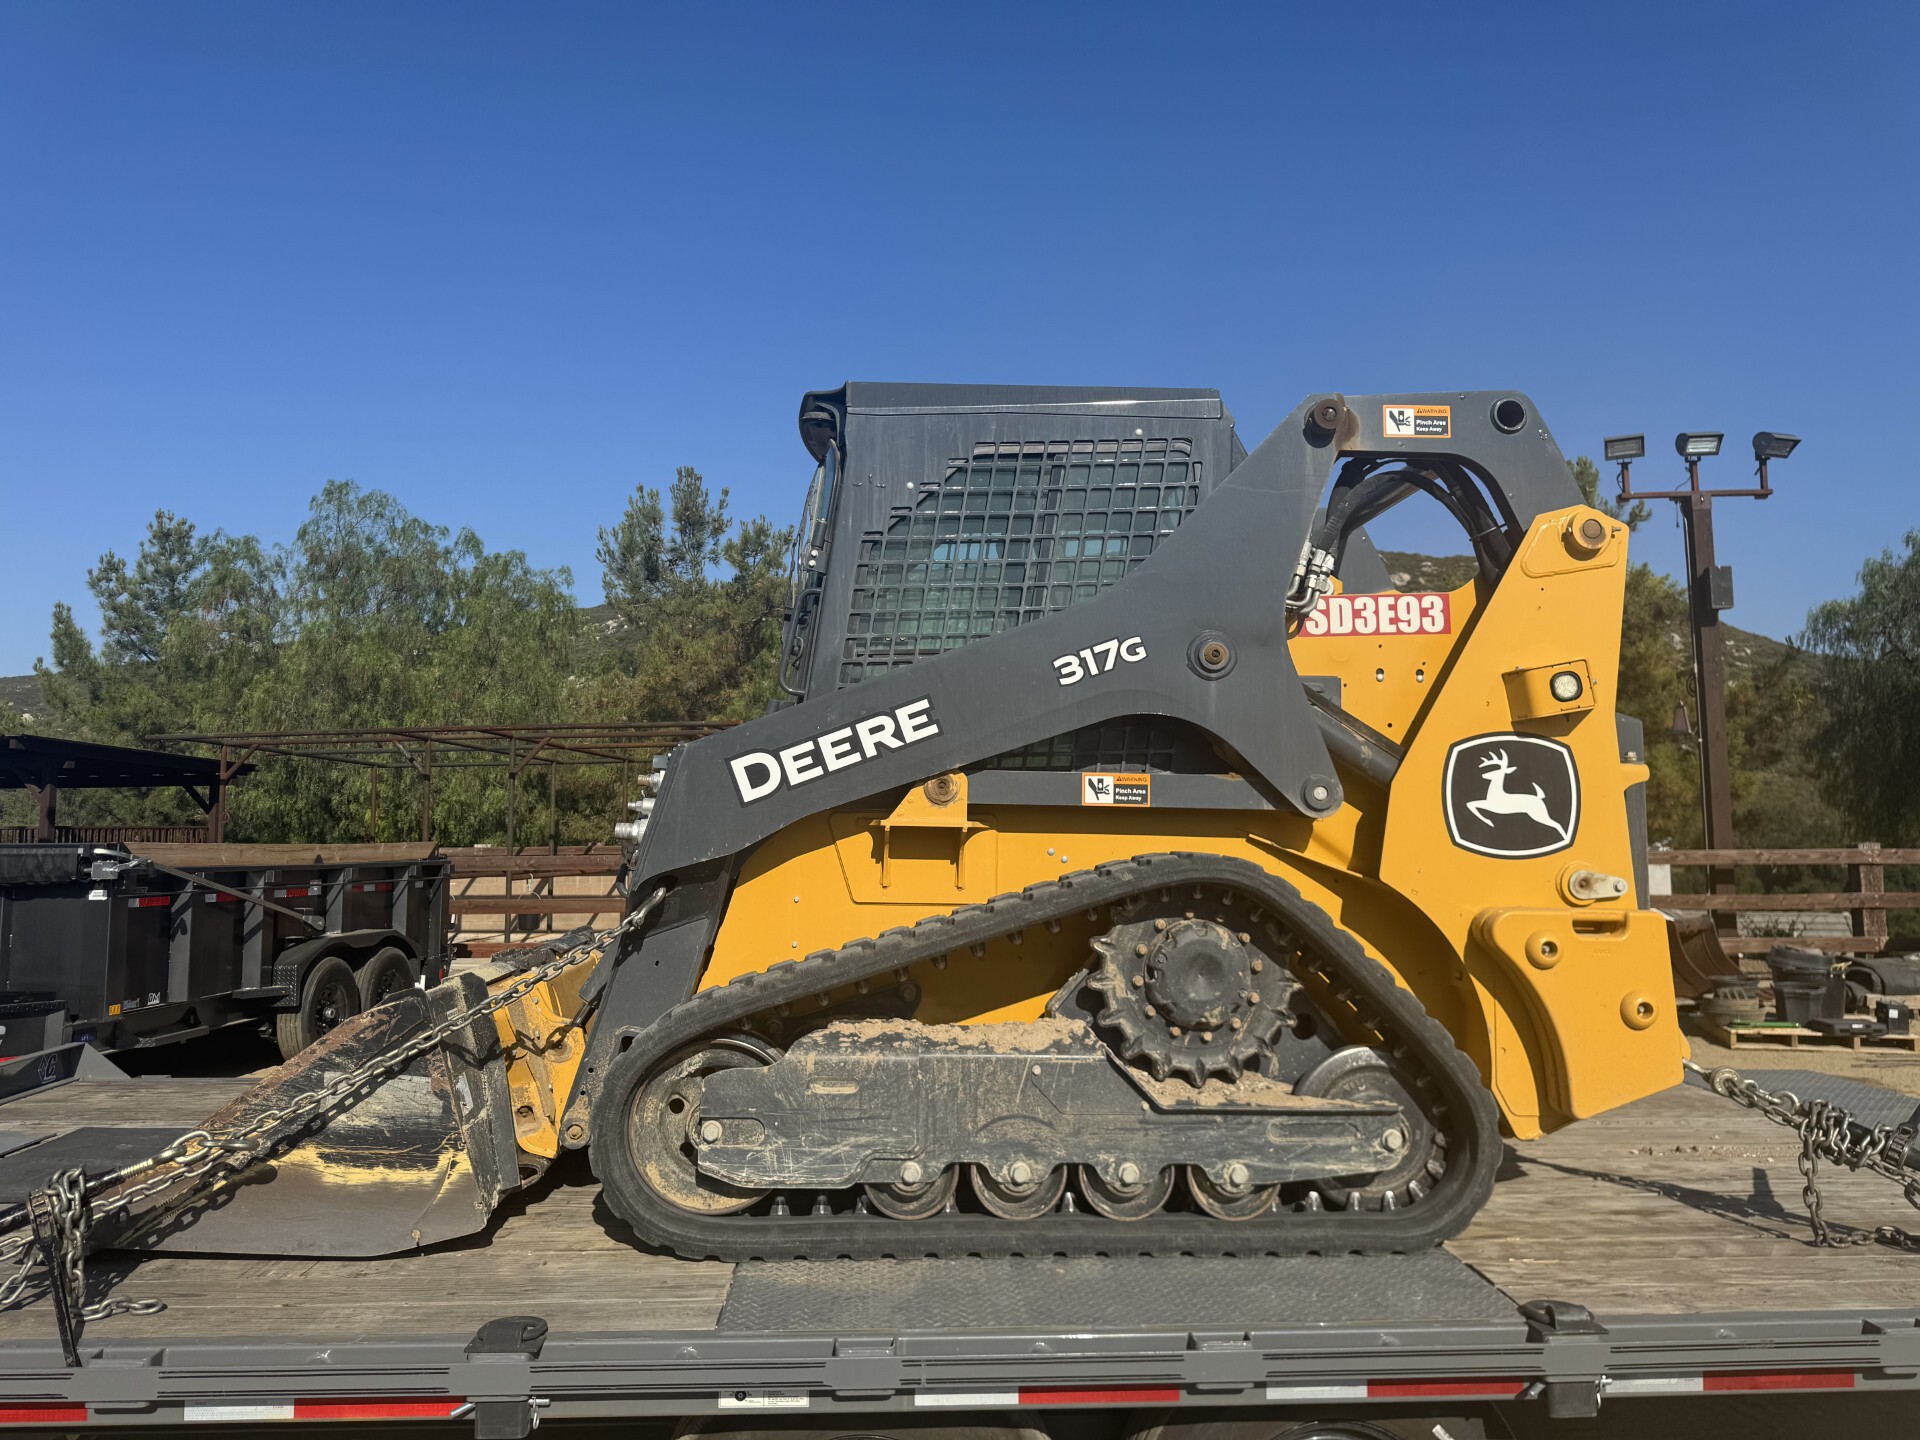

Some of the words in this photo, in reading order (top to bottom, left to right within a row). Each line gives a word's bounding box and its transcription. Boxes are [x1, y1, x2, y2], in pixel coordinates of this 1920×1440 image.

[1305, 595, 1445, 635] SD3E93
[1053, 636, 1147, 685] 317G
[730, 698, 939, 803] DEERE
